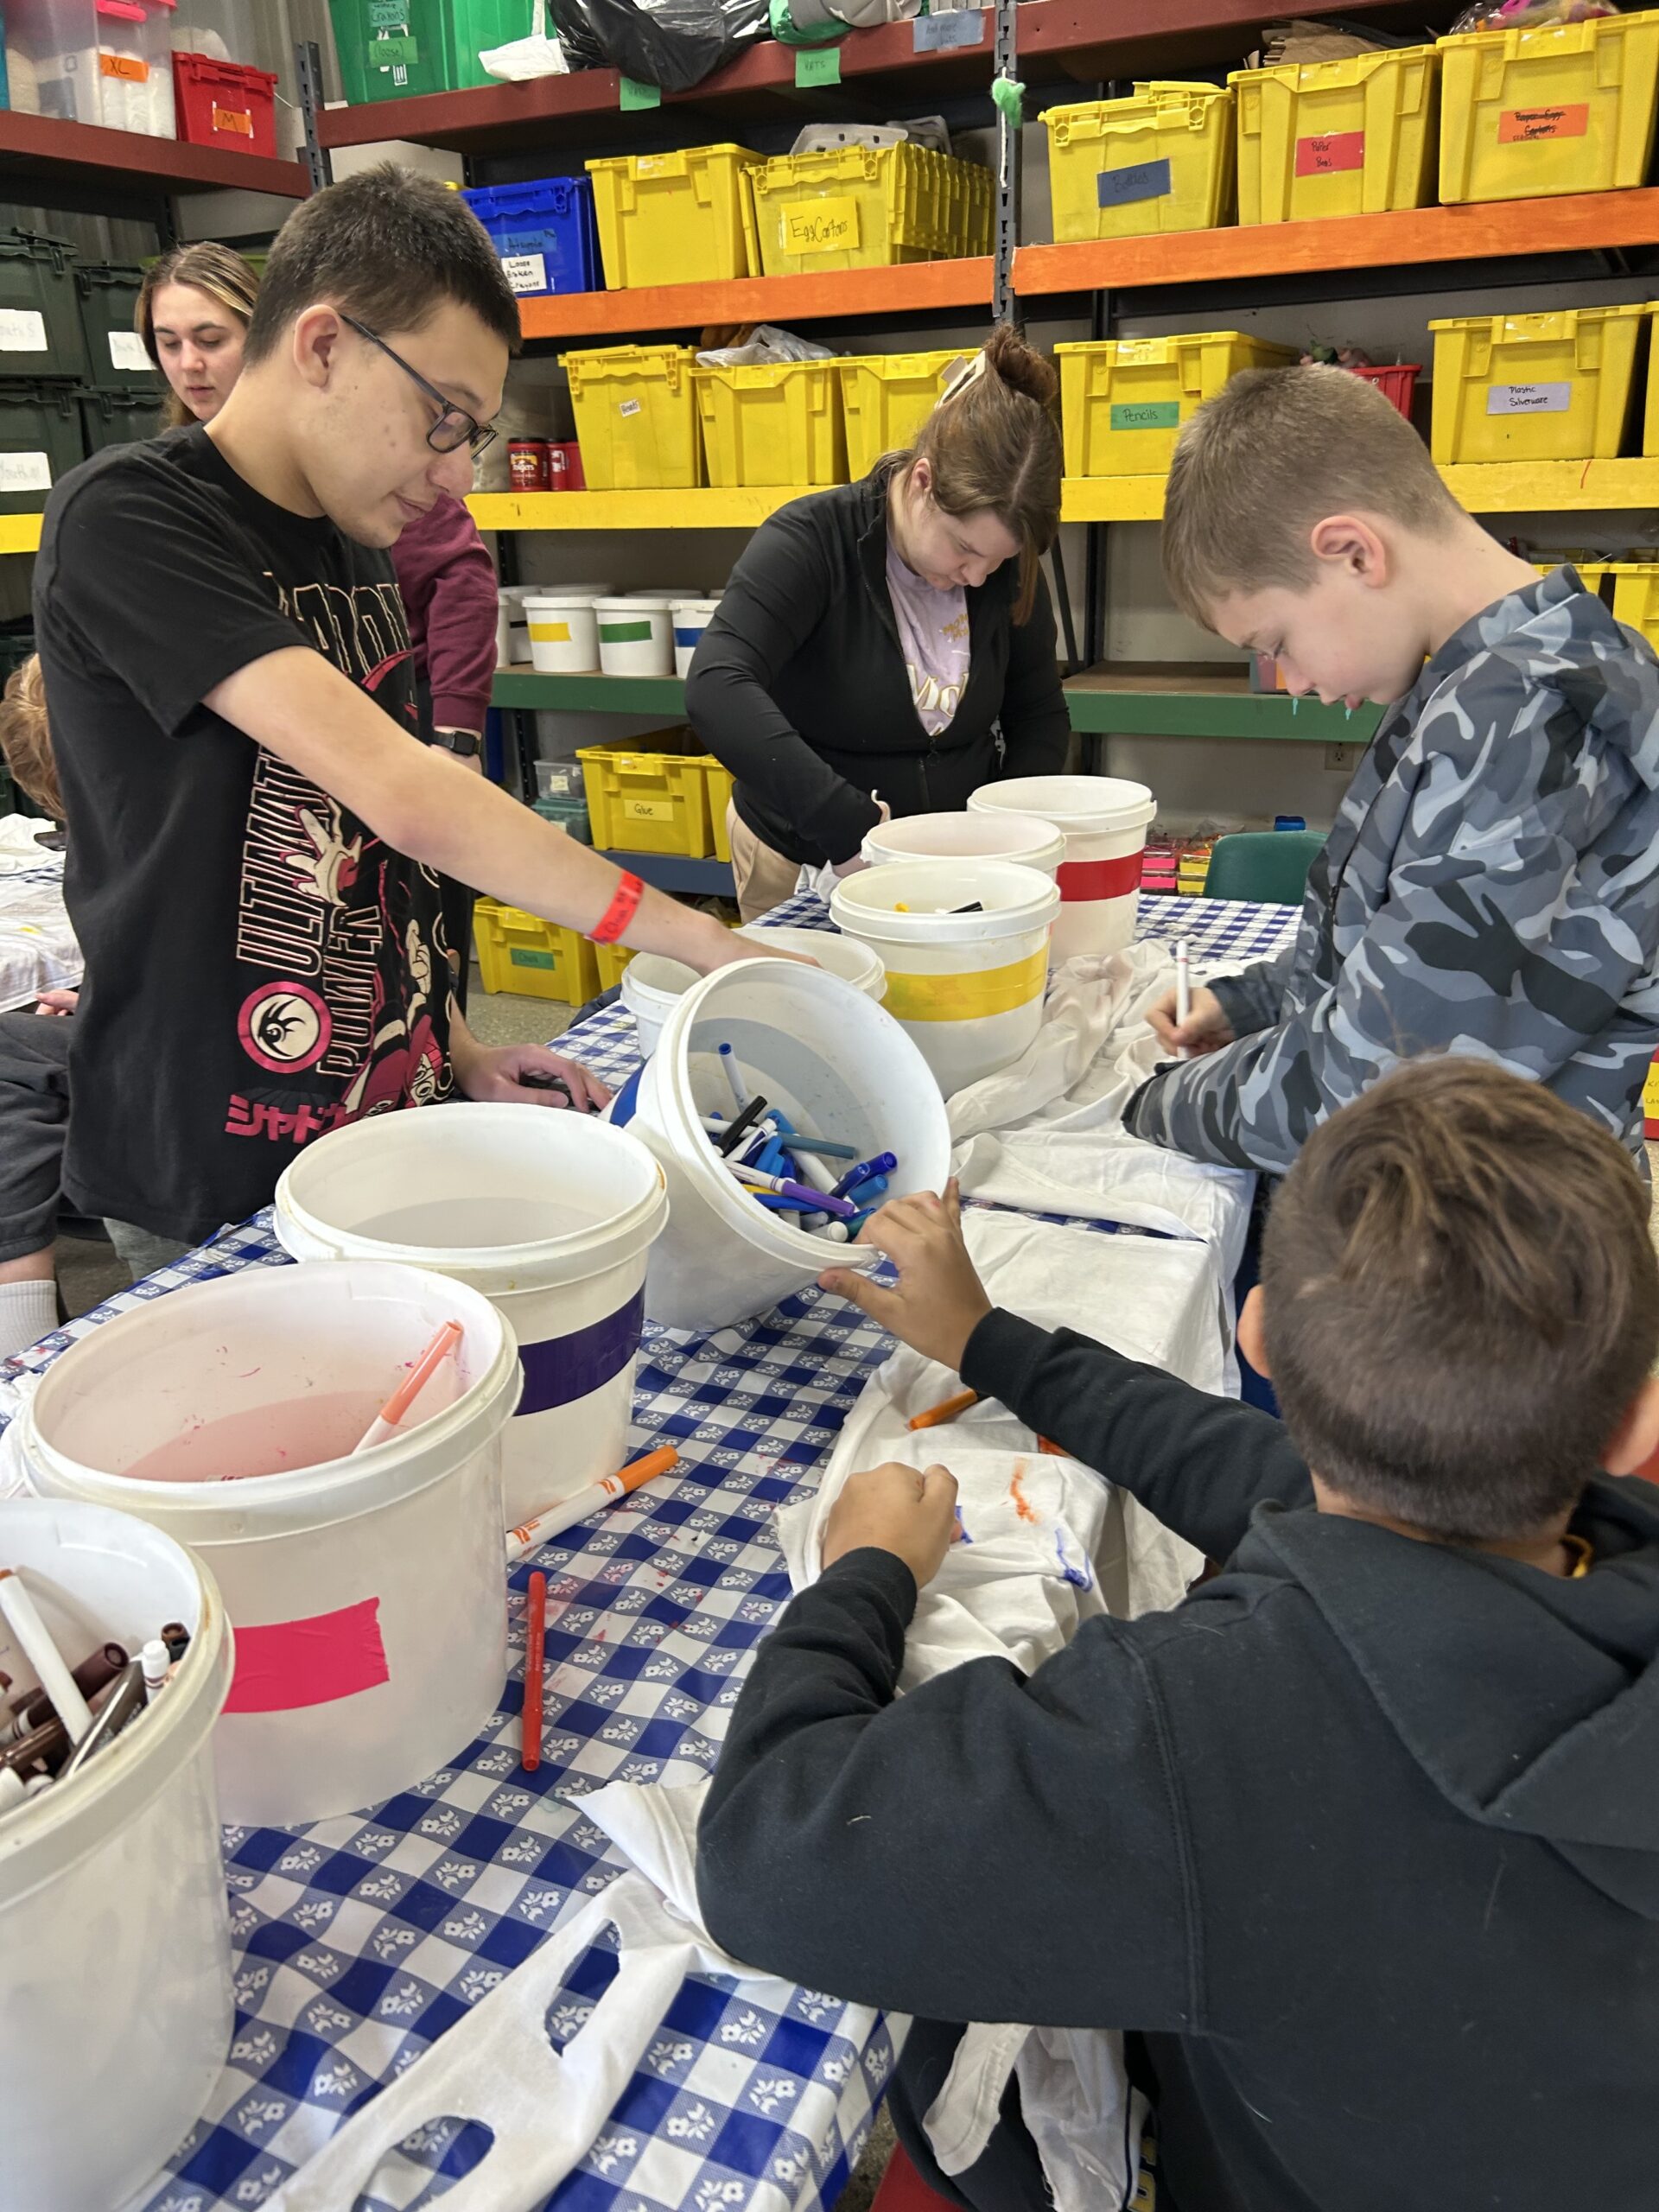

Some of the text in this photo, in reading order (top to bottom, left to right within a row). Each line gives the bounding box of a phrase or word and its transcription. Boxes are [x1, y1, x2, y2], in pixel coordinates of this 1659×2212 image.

[110, 59, 130, 75] XL
[222, 112, 239, 131] M
[1510, 397, 1548, 407] Silverware
[1123, 408, 1158, 423] Pencils
[634, 804, 654, 816] Glue
